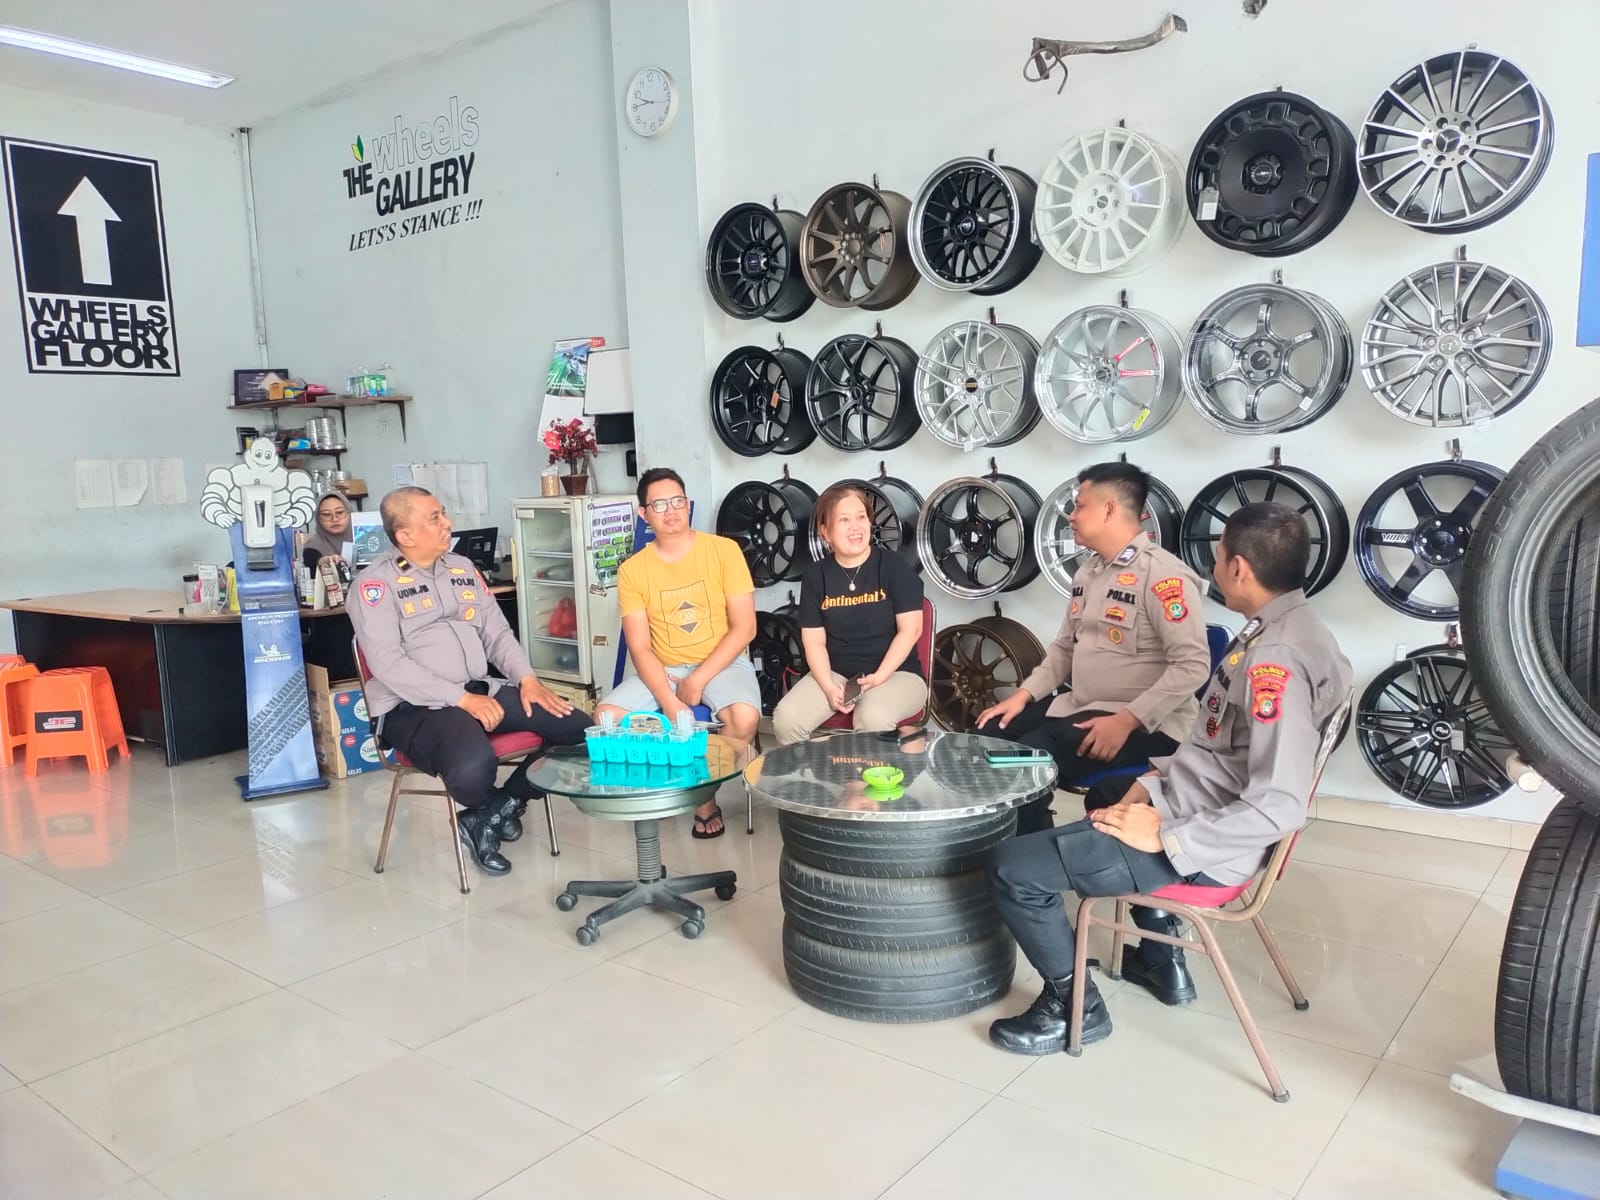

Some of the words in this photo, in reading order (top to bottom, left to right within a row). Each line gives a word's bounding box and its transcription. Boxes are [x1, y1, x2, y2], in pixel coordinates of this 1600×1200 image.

[372, 96, 480, 174] wheels
[343, 162, 374, 199] THE
[376, 151, 475, 216] GALLERY
[349, 222, 397, 251] LETS'S
[400, 204, 462, 238] STANCE
[29, 297, 167, 327] WHEELS
[30, 320, 170, 348] GALLERY
[34, 340, 172, 369] FLOOR
[1106, 588, 1136, 605] POLRI
[254, 655, 292, 664] MICHELIN
